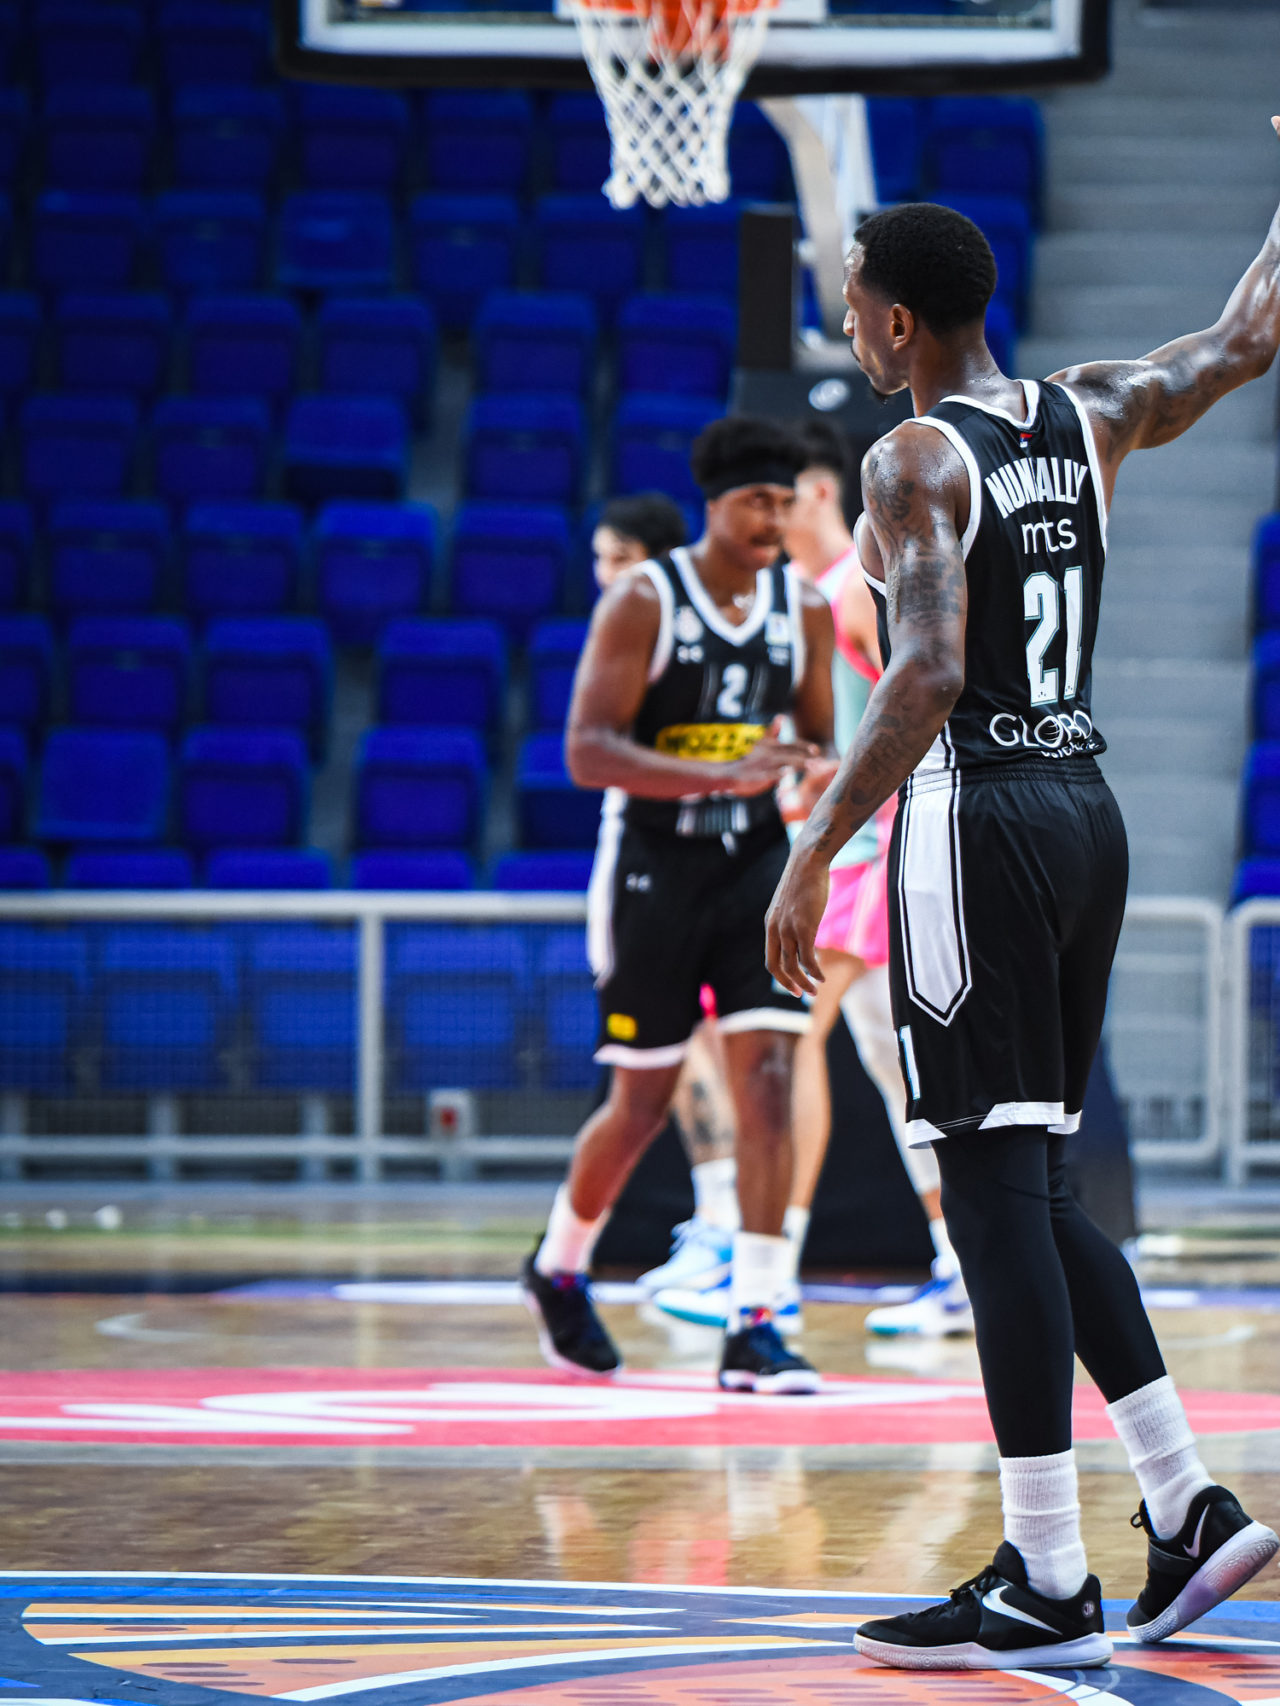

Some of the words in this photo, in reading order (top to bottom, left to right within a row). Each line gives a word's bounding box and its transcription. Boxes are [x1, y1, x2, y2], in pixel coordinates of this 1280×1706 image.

[1021, 515, 1077, 554] mts
[1024, 565, 1083, 708] 21
[717, 663, 748, 718] 2
[896, 1025, 920, 1100] 1
